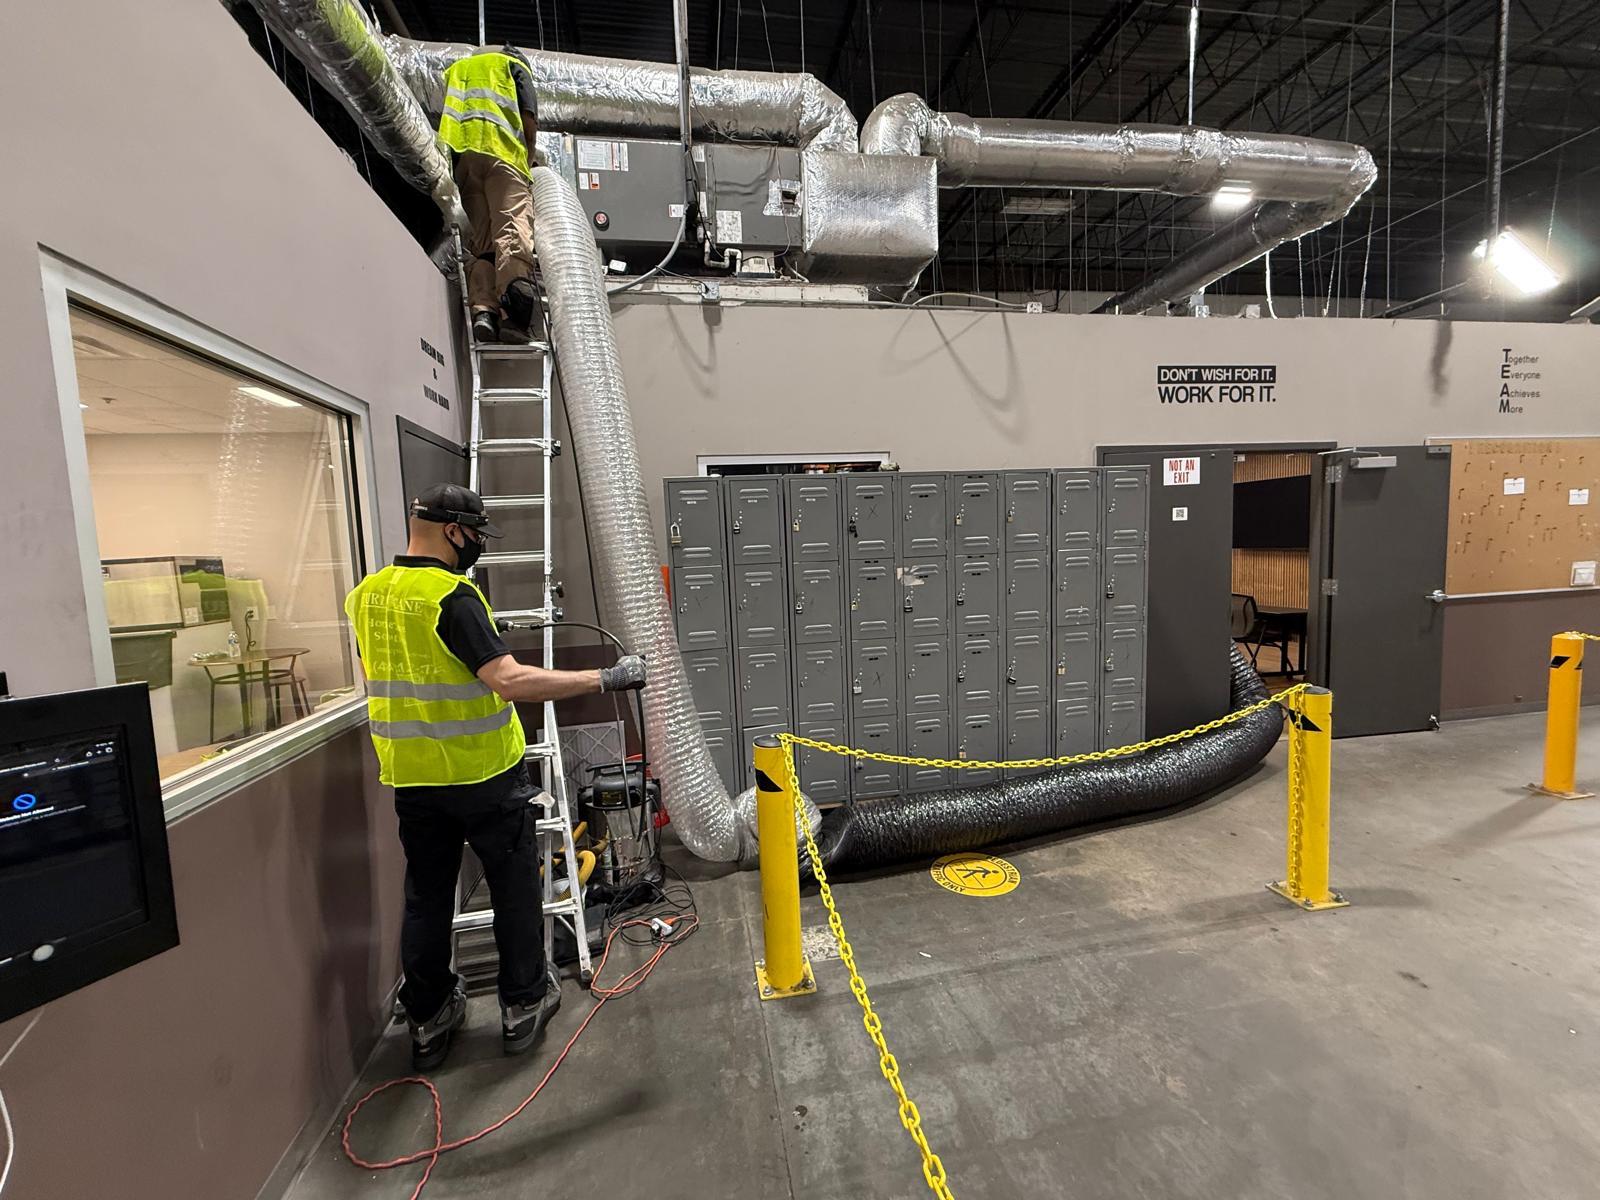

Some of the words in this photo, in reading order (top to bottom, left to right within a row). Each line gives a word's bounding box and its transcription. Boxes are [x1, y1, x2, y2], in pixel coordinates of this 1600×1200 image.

[1502, 348, 1539, 366] Together
[1160, 368, 1199, 382] DON'T
[1200, 368, 1233, 382] WISH
[1234, 367, 1259, 381] FOR
[1261, 367, 1274, 381] IT.
[1501, 364, 1541, 382] Everyone
[1157, 385, 1214, 404] WORK
[1218, 385, 1255, 403] FOR
[1259, 385, 1277, 403] IT.
[1500, 382, 1541, 399] Achieves
[1499, 398, 1524, 414] More
[1169, 459, 1183, 472] NOT
[1185, 458, 1195, 471] AN
[1173, 471, 1190, 484] EXIT
